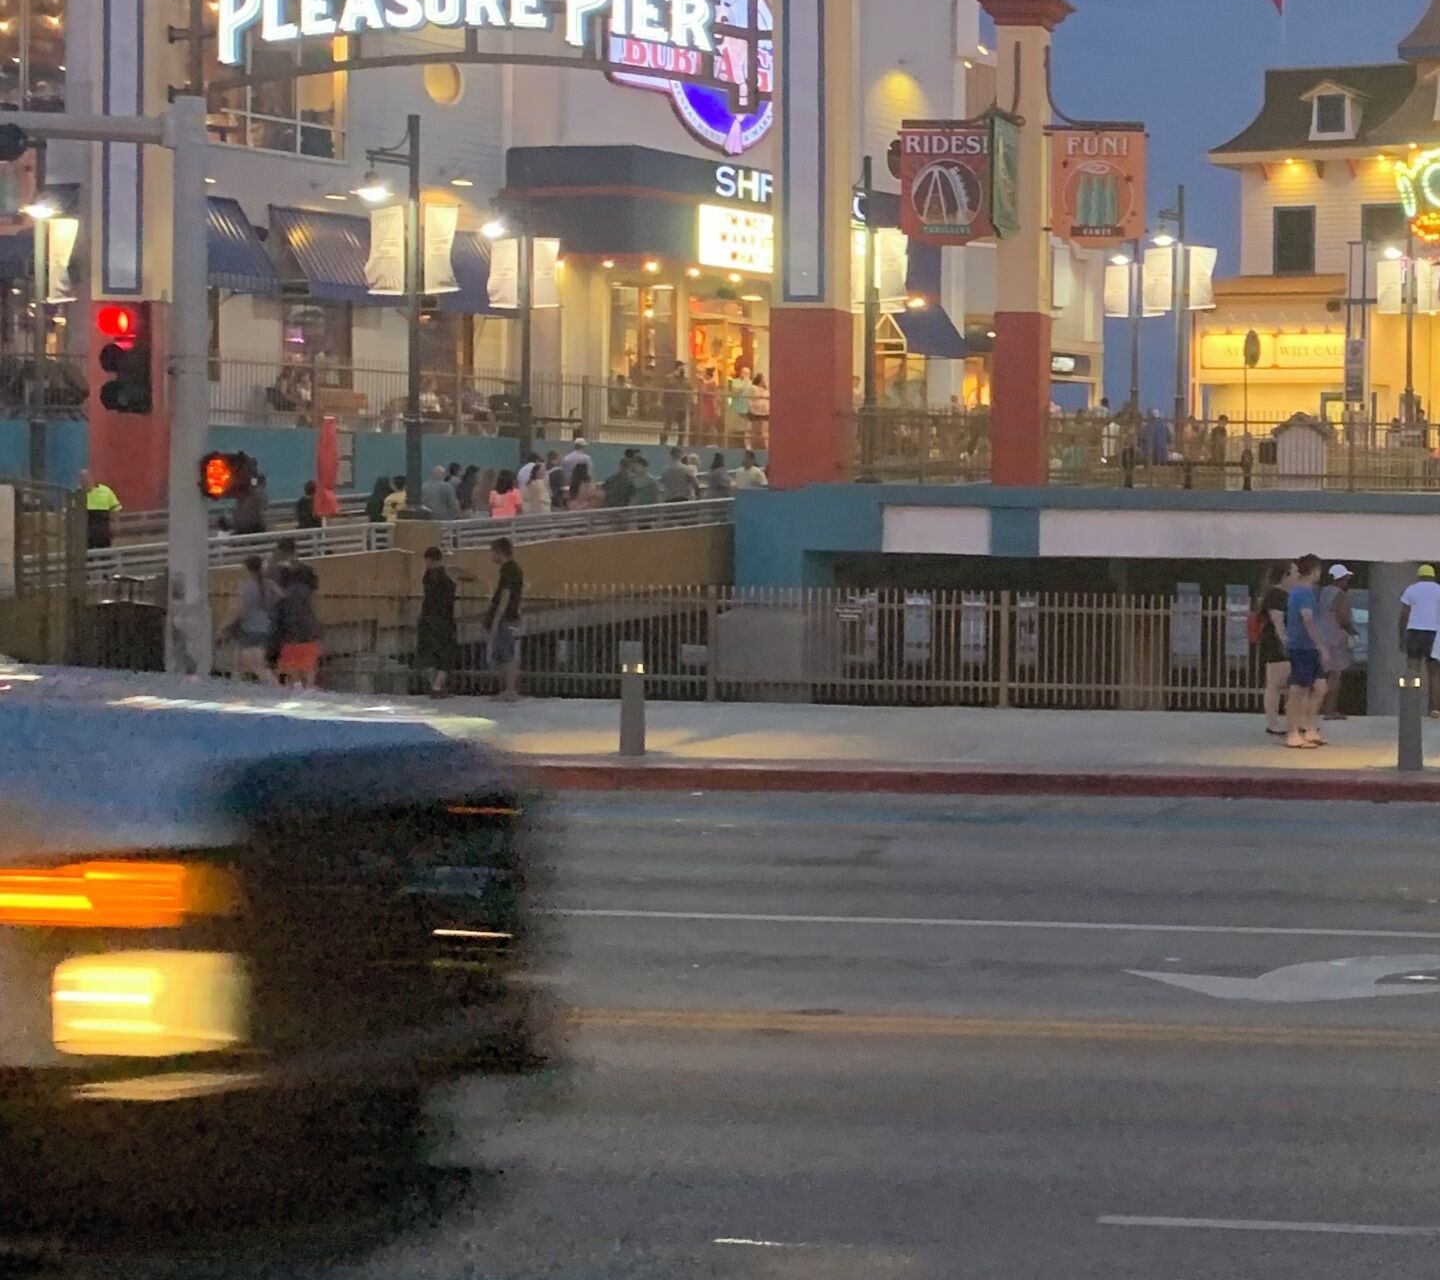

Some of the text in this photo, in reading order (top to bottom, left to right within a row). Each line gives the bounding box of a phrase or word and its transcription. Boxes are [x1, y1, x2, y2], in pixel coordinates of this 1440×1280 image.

[905, 135, 988, 154] RIDES!
[1066, 135, 1128, 157] FUN!
[1280, 345, 1309, 357] WILL
